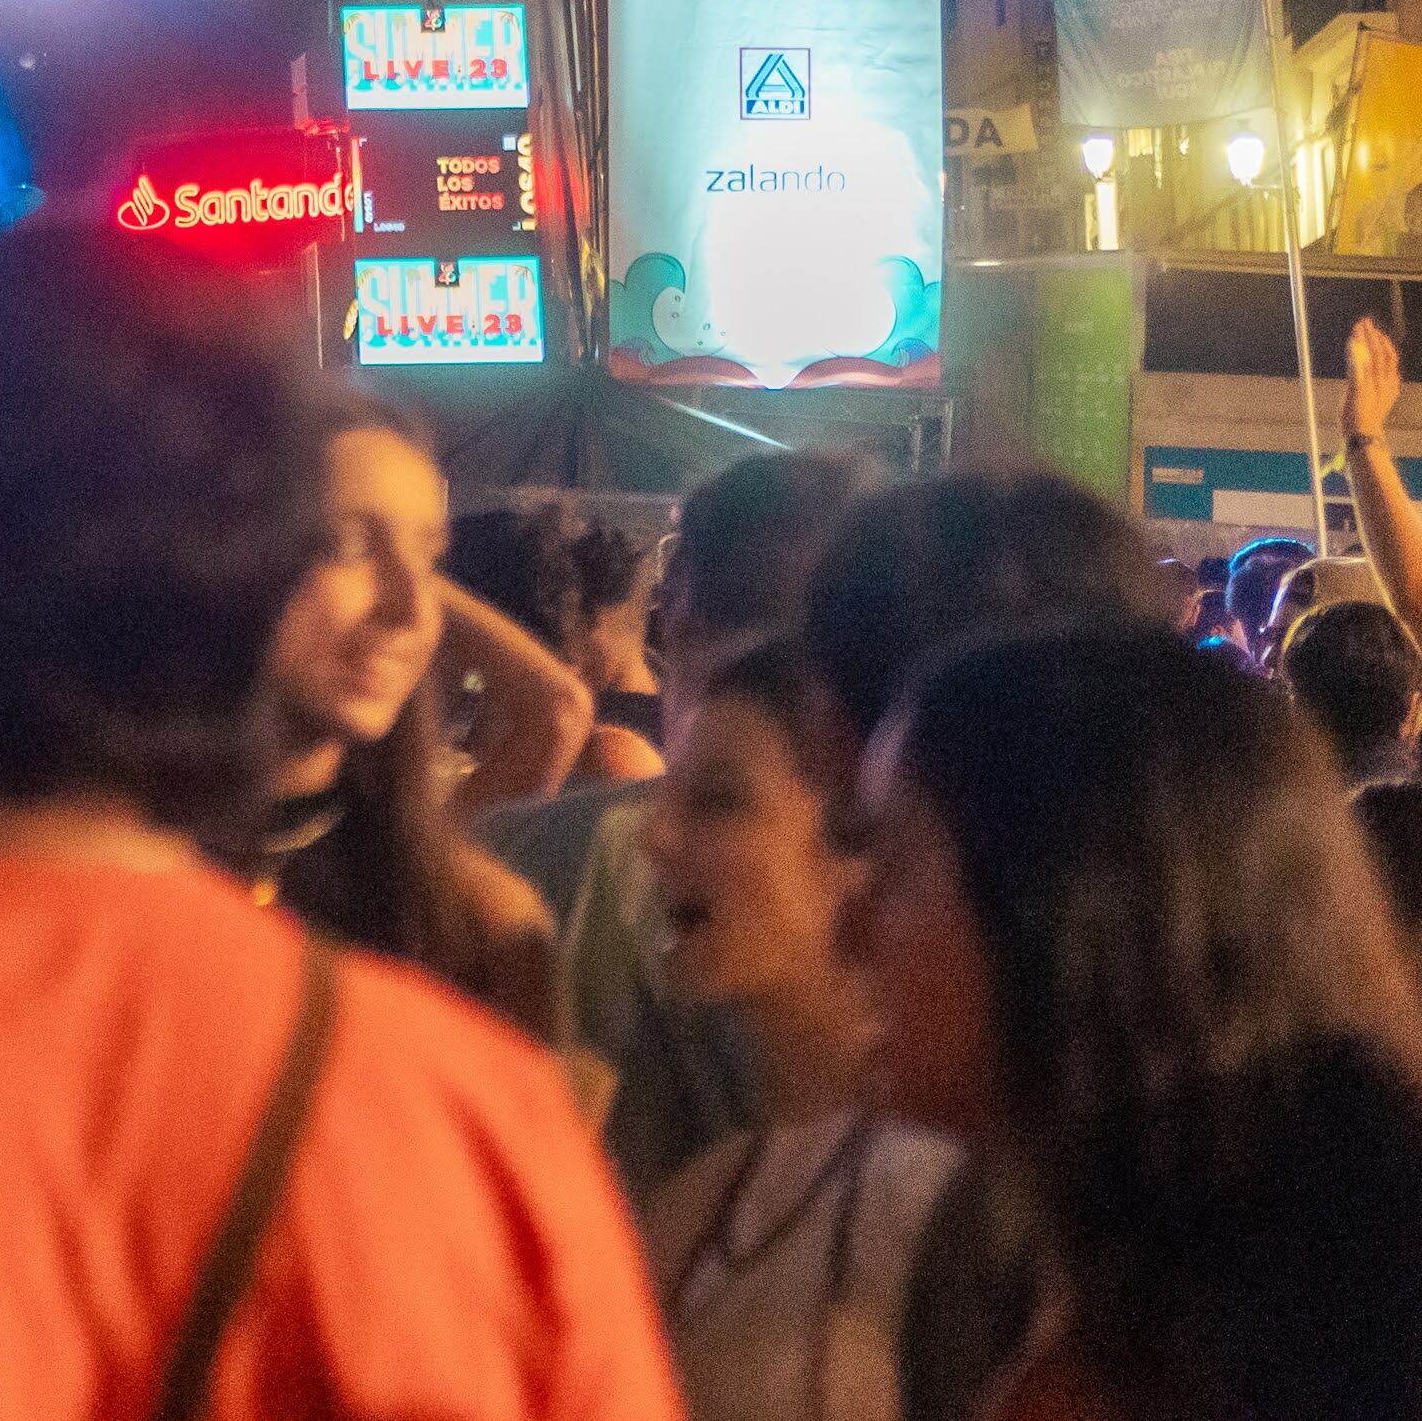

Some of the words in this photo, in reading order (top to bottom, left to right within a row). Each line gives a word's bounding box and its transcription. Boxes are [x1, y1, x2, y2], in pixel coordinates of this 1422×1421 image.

[346, 9, 522, 85] SUMMER
[363, 59, 450, 80] LIVE
[750, 99, 803, 115] ALDI
[437, 155, 502, 175] TODOS
[437, 175, 475, 193] LOS
[706, 164, 847, 193] zalando
[174, 171, 356, 229] Santand
[437, 191, 506, 212] ÉXITOS
[360, 263, 538, 345] SUMMER
[376, 315, 464, 337] LIVE
